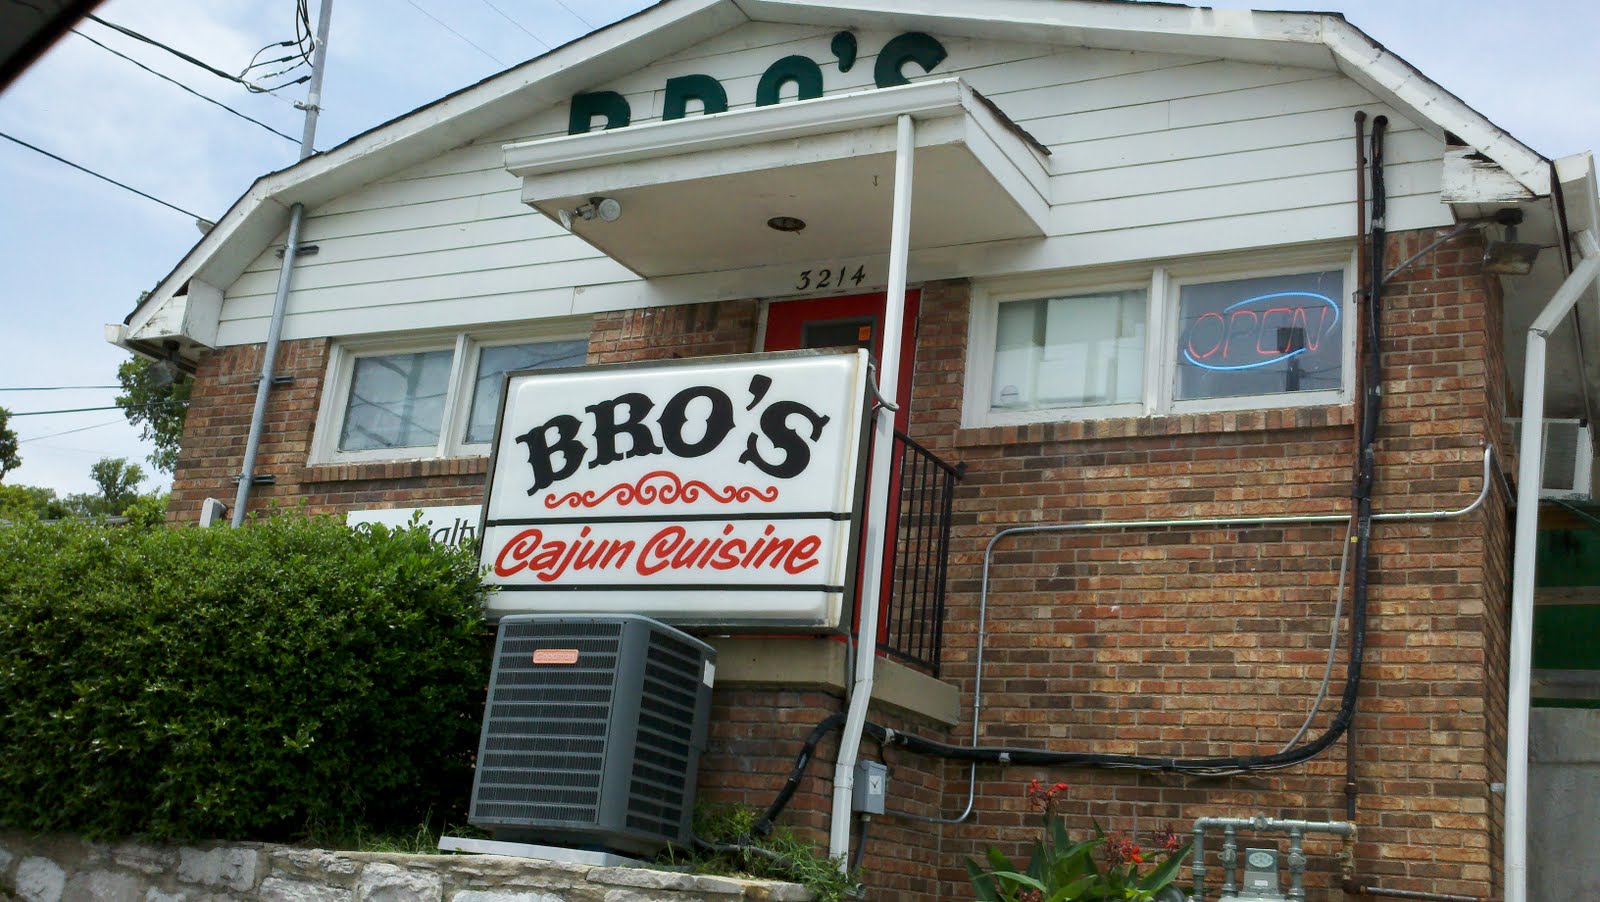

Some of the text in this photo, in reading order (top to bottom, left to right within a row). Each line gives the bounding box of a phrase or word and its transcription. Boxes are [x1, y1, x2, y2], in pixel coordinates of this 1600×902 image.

[796, 264, 866, 290] 3214
[515, 374, 831, 497] BRO'S
[494, 525, 636, 582] Cajun
[636, 523, 822, 576] Cuisine
